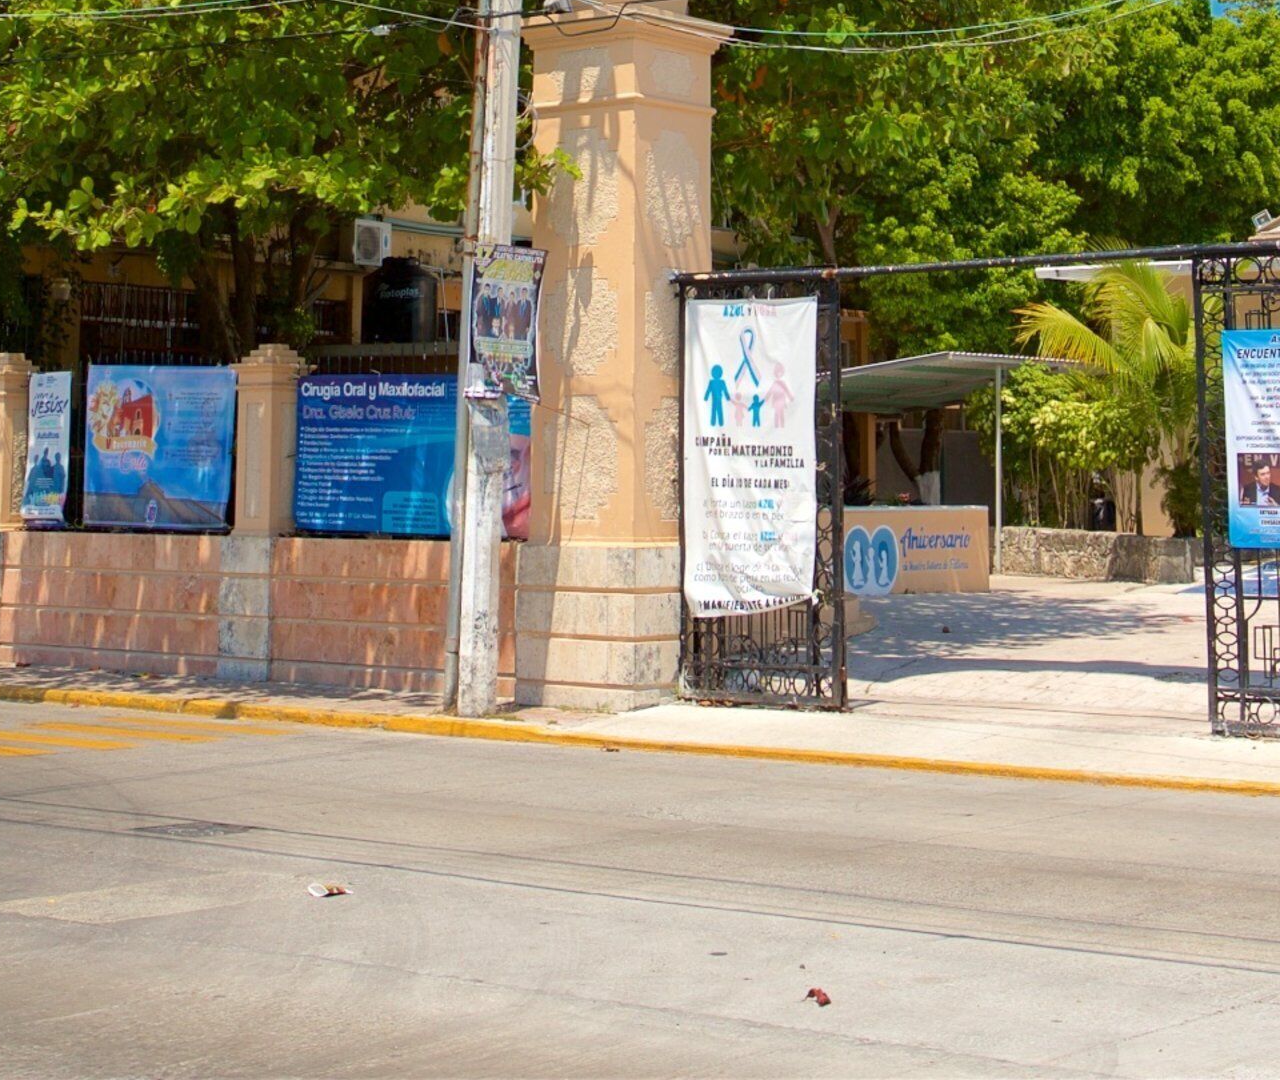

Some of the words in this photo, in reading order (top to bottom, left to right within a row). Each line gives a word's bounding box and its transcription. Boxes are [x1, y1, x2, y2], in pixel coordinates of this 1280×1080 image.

[723, 305, 744, 317] AZUL
[301, 382, 340, 400] Cirugía
[343, 382, 366, 396] Oral
[369, 386, 376, 400] y
[366, 405, 391, 419] Cruz
[732, 445, 793, 456] MATRIMONIO
[770, 459, 805, 468] FAMILIA
[711, 477, 719, 487] EL
[900, 526, 971, 558] Aniversario
